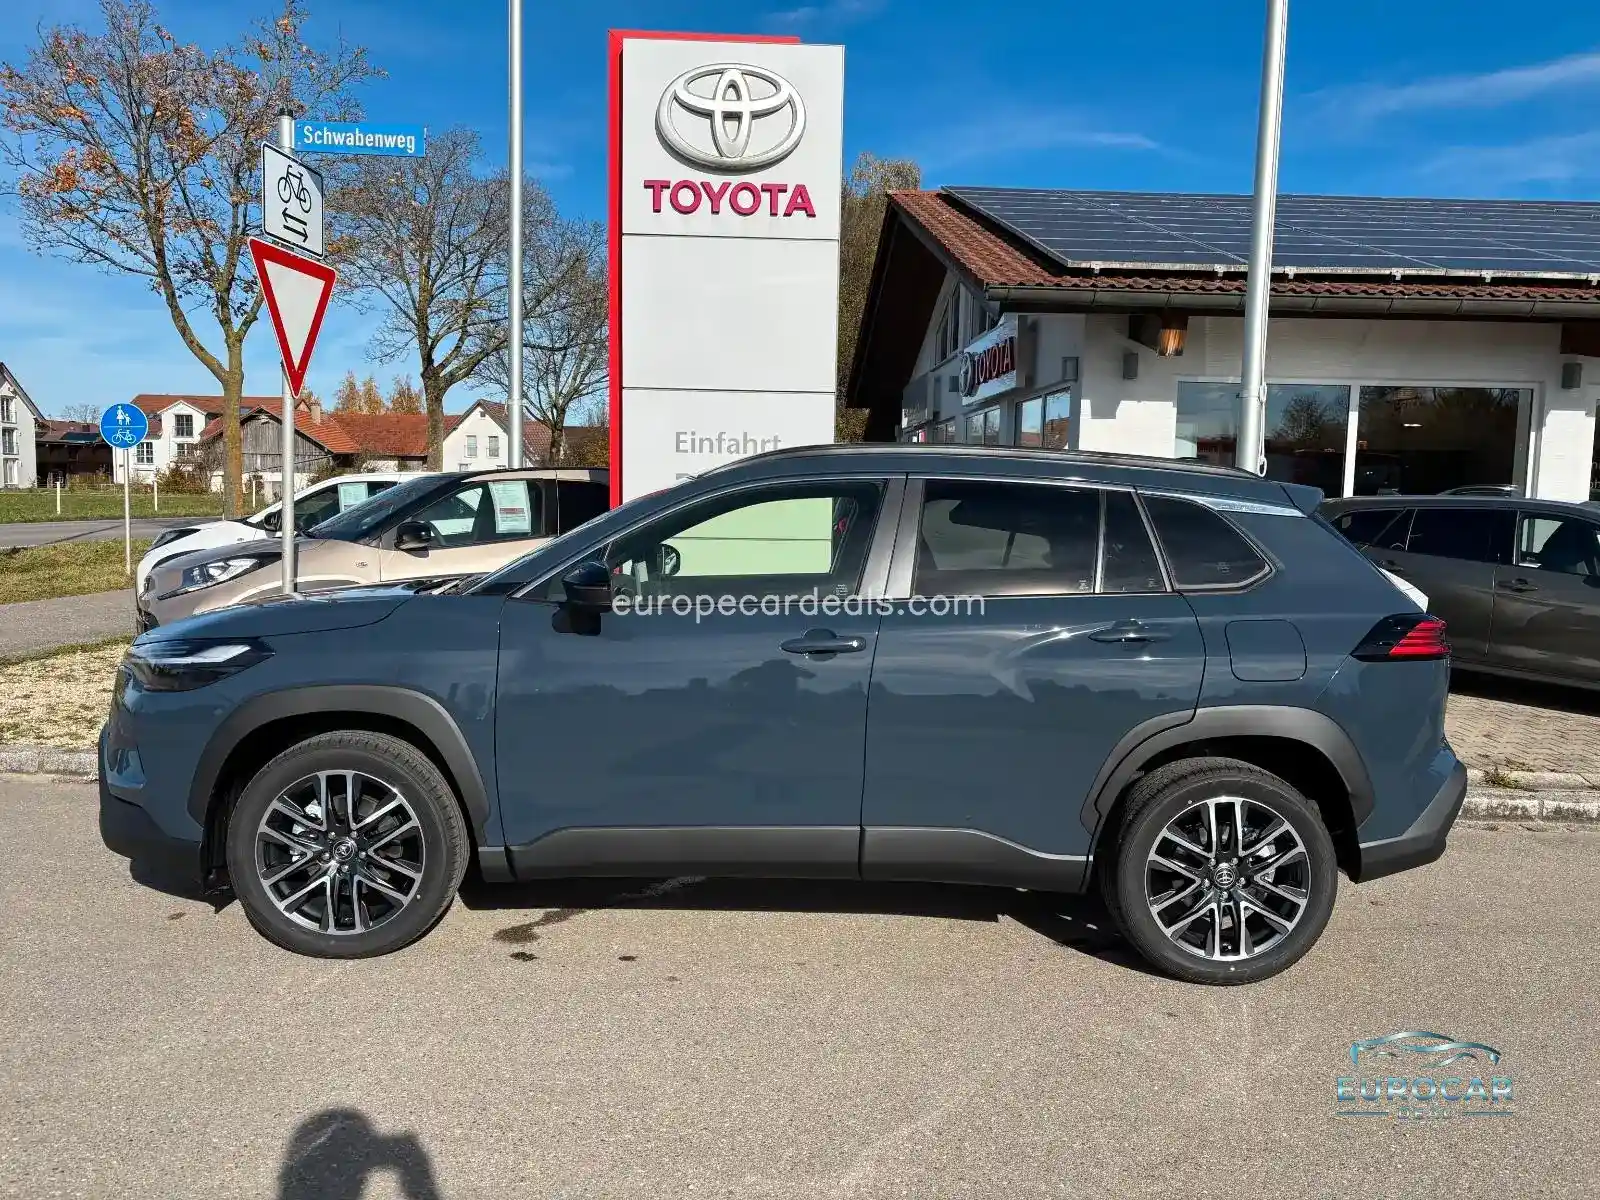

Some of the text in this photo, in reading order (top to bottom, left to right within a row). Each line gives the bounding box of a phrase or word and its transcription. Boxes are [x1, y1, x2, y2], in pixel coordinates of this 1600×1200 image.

[303, 125, 416, 154] Schwabenweg
[643, 179, 817, 218] TOYOTA
[974, 336, 1017, 386] TOYOTA
[675, 431, 782, 455] Einfahrt
